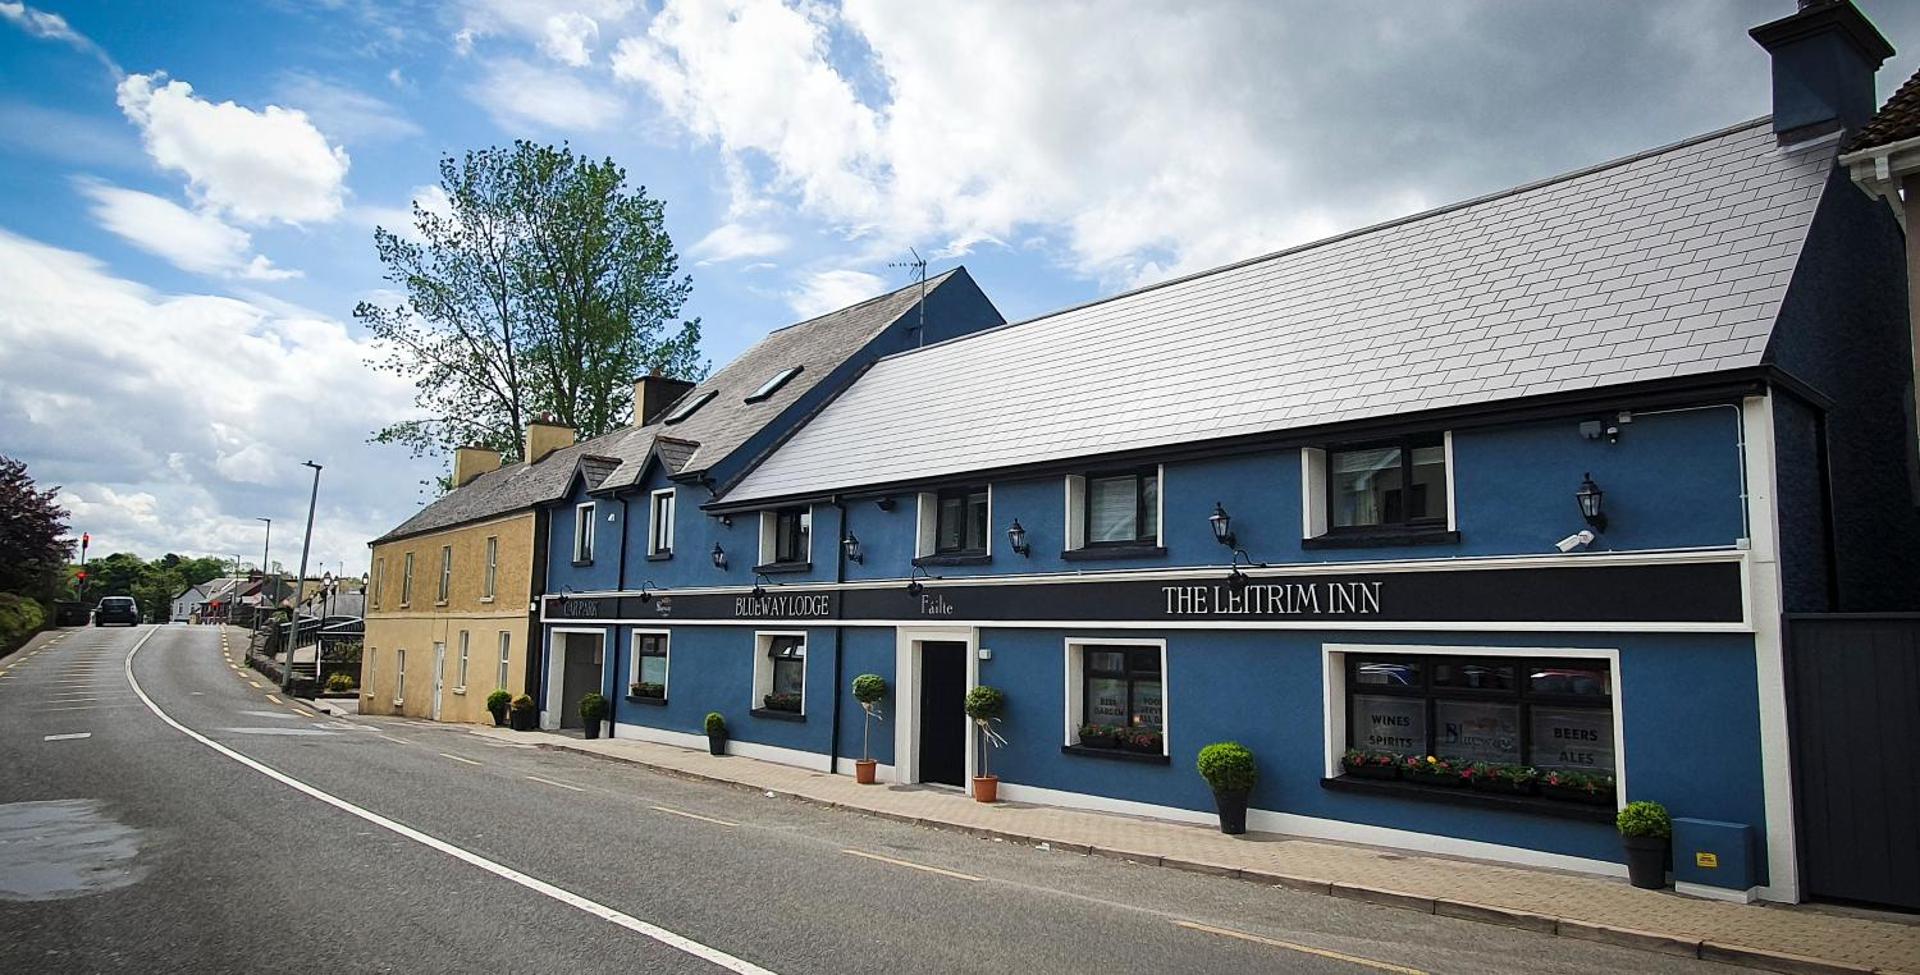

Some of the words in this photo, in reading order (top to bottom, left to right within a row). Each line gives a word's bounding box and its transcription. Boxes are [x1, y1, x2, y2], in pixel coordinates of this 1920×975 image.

[735, 596, 787, 616] BLUEWAY
[788, 595, 829, 616] LODGE
[920, 593, 953, 615] Fáilte
[1161, 586, 1208, 614] THE
[1213, 583, 1322, 614] LEITRIM
[1327, 581, 1384, 614] INN
[1371, 711, 1410, 727] WINES
[1369, 734, 1413, 749] SPIRITS
[1554, 727, 1598, 742] BEERS
[1558, 751, 1594, 765] ALES
